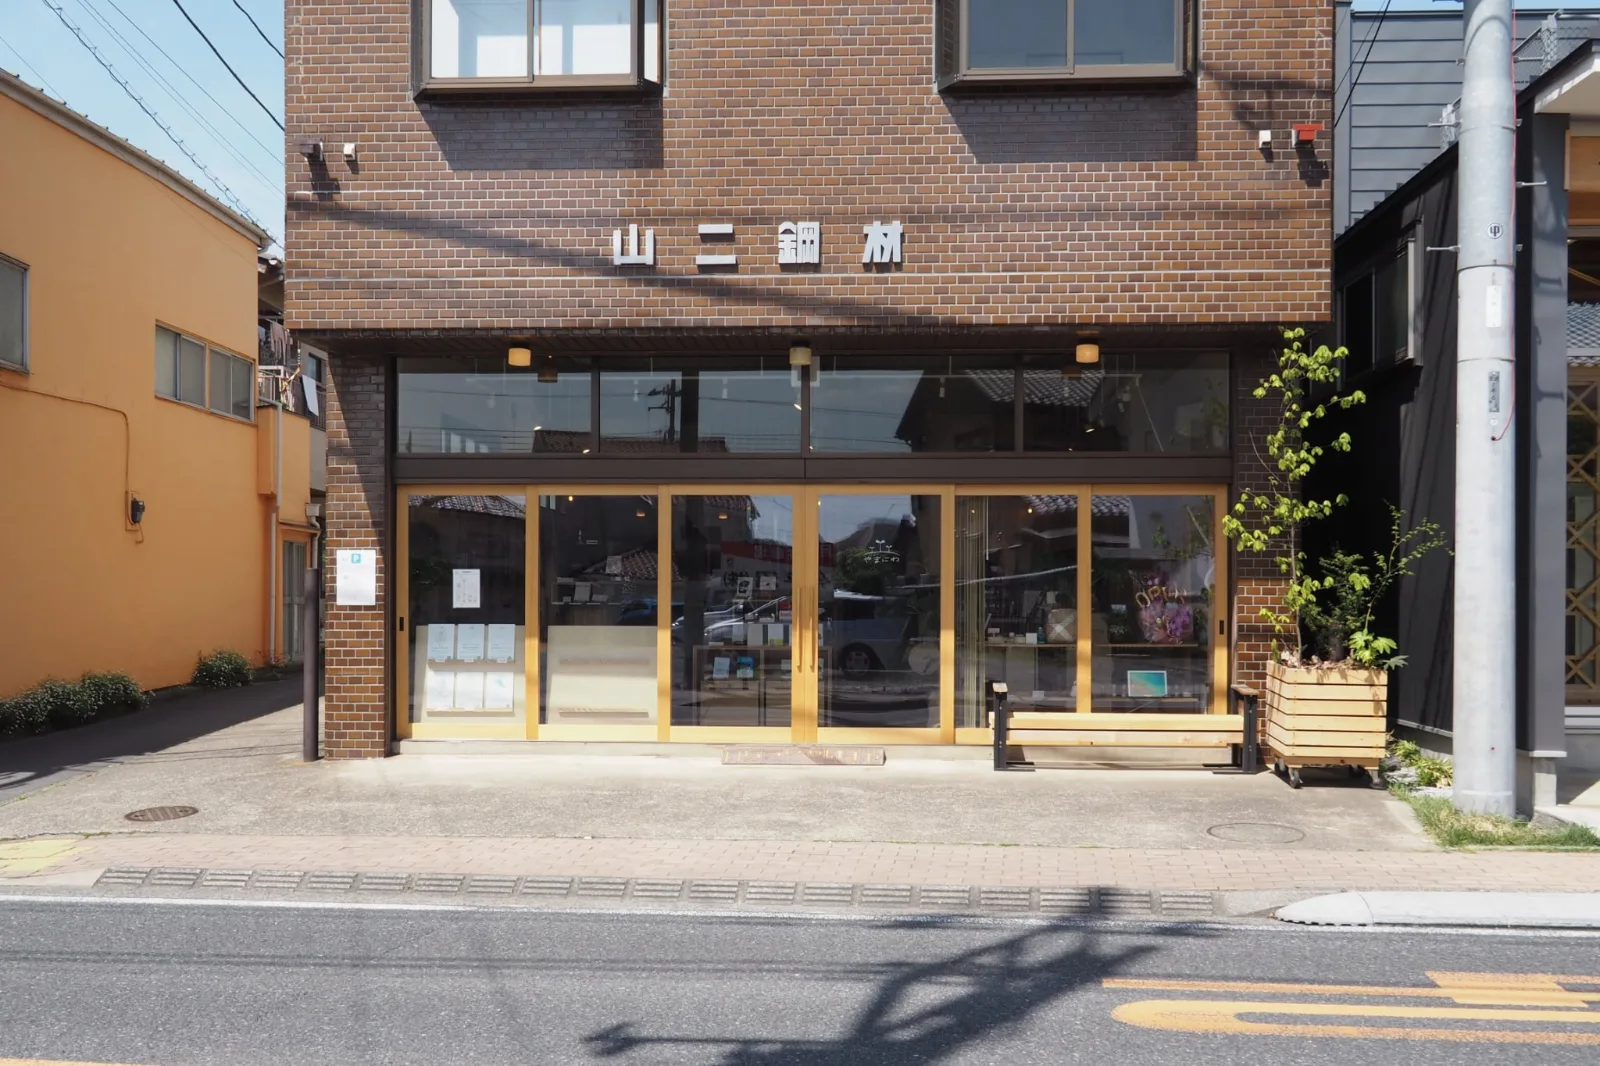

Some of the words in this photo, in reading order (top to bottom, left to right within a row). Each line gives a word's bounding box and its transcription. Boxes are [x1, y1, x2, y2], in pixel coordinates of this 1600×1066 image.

[613, 221, 903, 265] 山二鋼材
[864, 555, 900, 564] やまにわ
